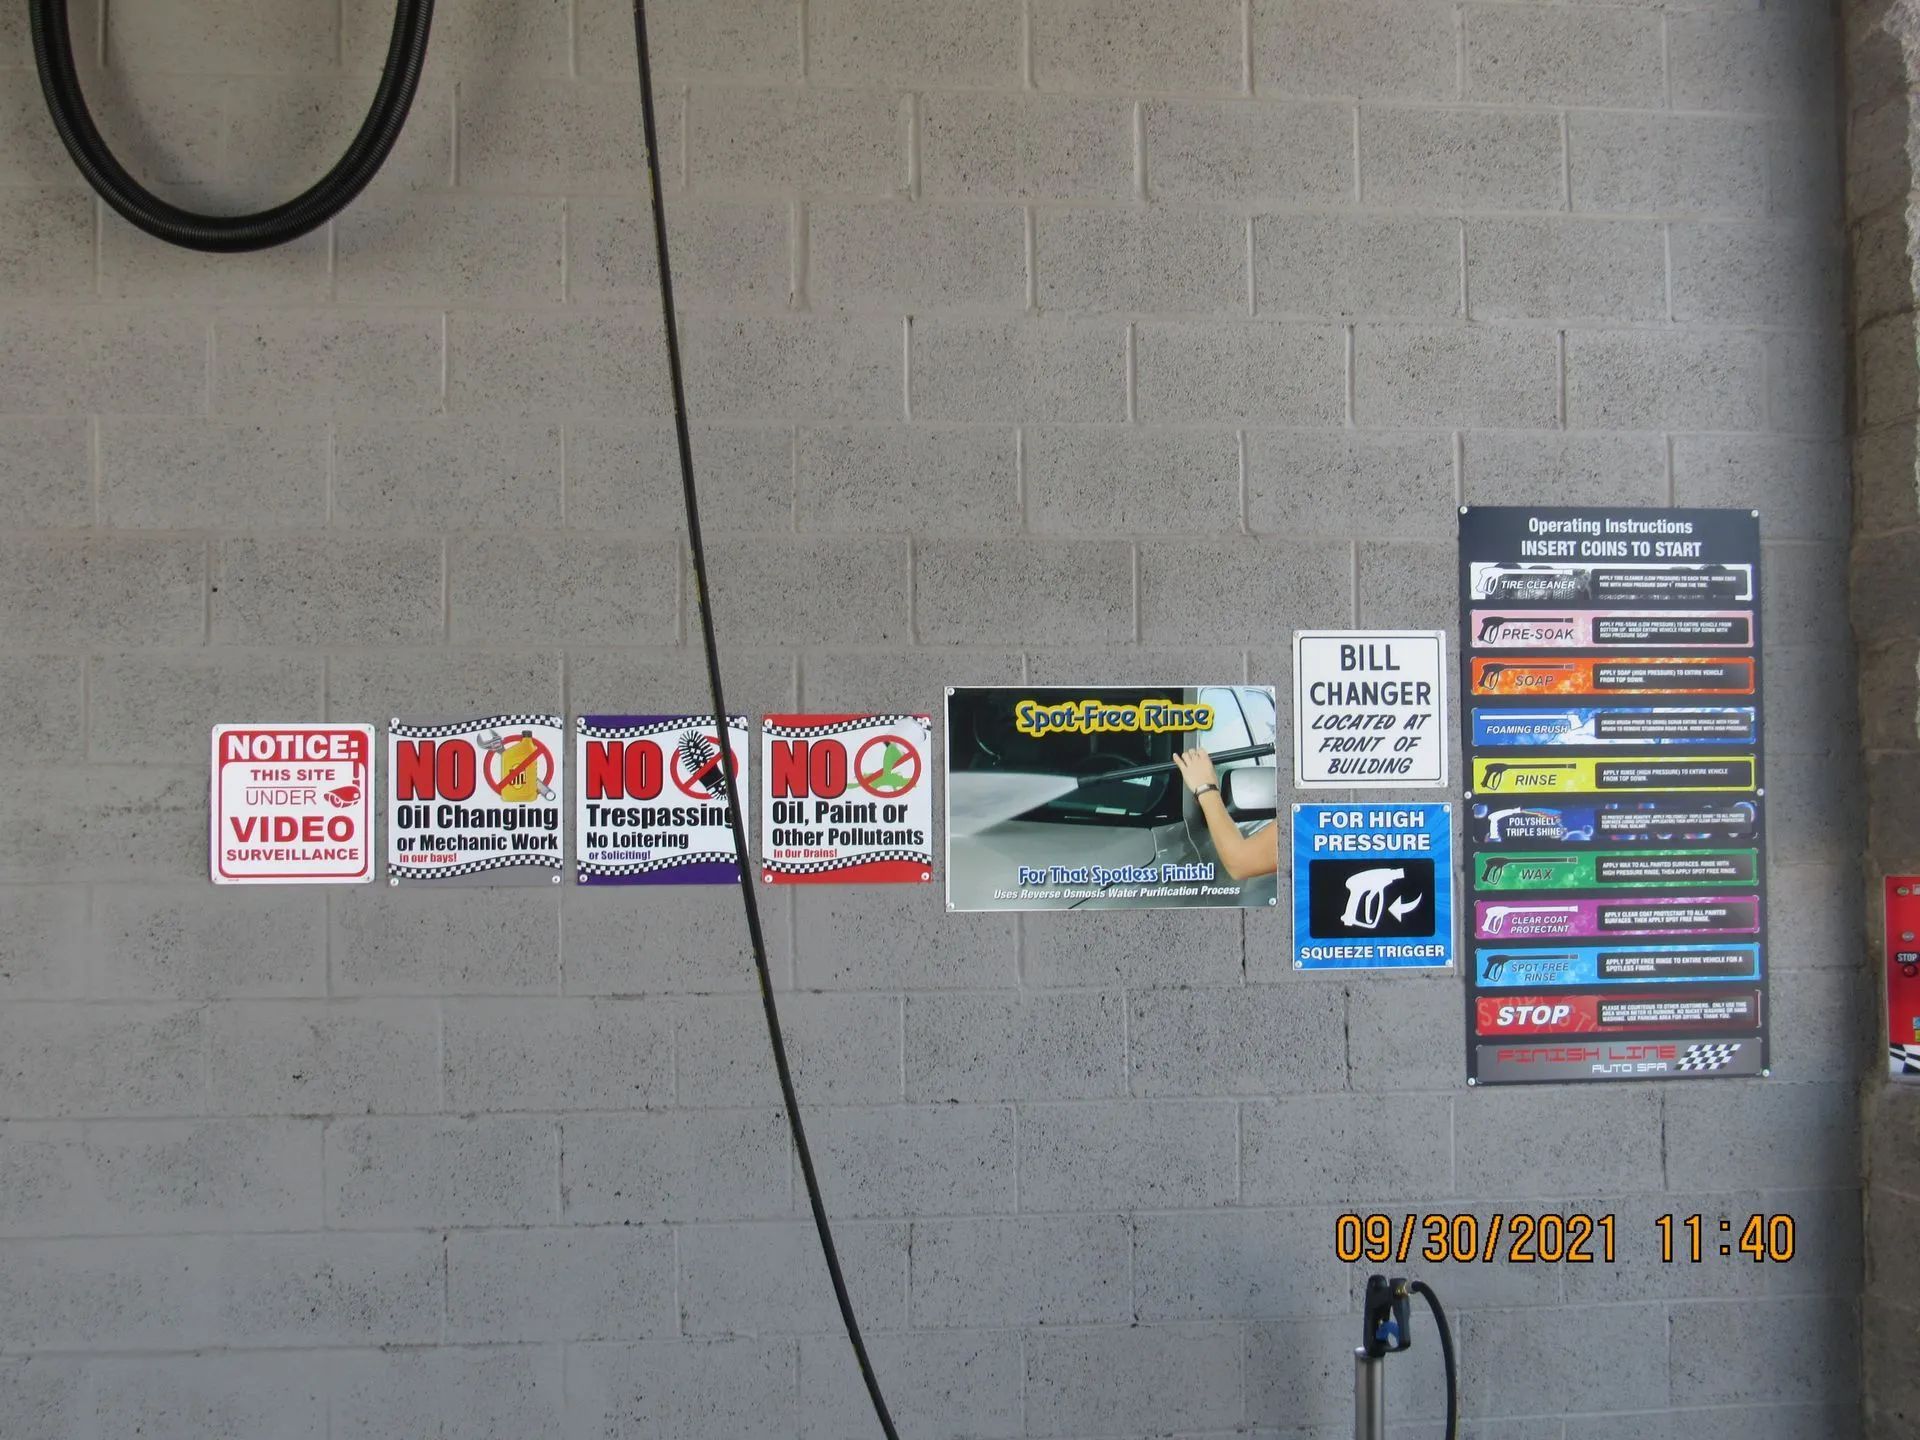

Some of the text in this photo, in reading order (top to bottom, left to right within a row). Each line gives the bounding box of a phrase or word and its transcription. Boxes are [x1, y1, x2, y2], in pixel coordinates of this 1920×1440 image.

[1528, 517, 1694, 536] Operating Instructions
[1521, 540, 1702, 557] INSERT COINS TO START
[1501, 580, 1576, 590] TIRE CLEANER
[1502, 628, 1574, 640] PRE-SOAK
[1340, 644, 1400, 671] BILL
[1515, 675, 1554, 686] SOAP
[1310, 681, 1431, 706] CHANGER
[1018, 702, 1210, 734] Spot-Free Rinse
[1311, 714, 1431, 730] LOCATED AT
[1486, 725, 1568, 735] FOAMING BRUSH
[228, 734, 359, 760] NOTICE:
[1319, 736, 1422, 752] FRONT OF
[397, 739, 476, 801] NO
[586, 739, 663, 800] NO
[771, 739, 847, 799] NO
[1327, 757, 1414, 774] BUILDING
[251, 769, 336, 781] THIS SITE
[1514, 774, 1557, 786] RINSE
[246, 789, 317, 806] UNDER
[397, 804, 558, 831] Oil Changing
[772, 801, 908, 826] Oil, Paint or
[1319, 811, 1425, 829] FOR HIGH
[230, 815, 355, 843] VIDEO
[772, 828, 924, 846] Other Pollutants
[1506, 828, 1534, 837] TRIPLE
[397, 834, 558, 851] or Mechanic Work
[587, 832, 689, 850] No Loitering
[1314, 833, 1431, 852] PRESSURE
[227, 849, 359, 861] SURVEILLANCE
[411, 854, 429, 863] our
[430, 853, 457, 863] bays!
[589, 850, 651, 861] or Soliciting!
[785, 849, 803, 858] Our
[804, 849, 838, 859] Drains!
[1019, 863, 1215, 886] For That Spotless Finish!
[1520, 869, 1553, 880] WAX
[994, 884, 1241, 899] Uses Reverse Osmosis Water Purification Process
[1511, 915, 1568, 925] CLEAR COAT
[1510, 924, 1569, 934] PROTECTANT
[1300, 944, 1445, 960] SQUEEZE TRIGGER
[1897, 953, 1917, 963] STOP
[1511, 963, 1569, 973] SPOT FREE
[1525, 973, 1557, 982] RINSE
[1496, 1005, 1570, 1026] STOP
[1496, 1045, 1676, 1063] FINISH LINE
[1592, 1062, 1667, 1073] AUTO SPA
